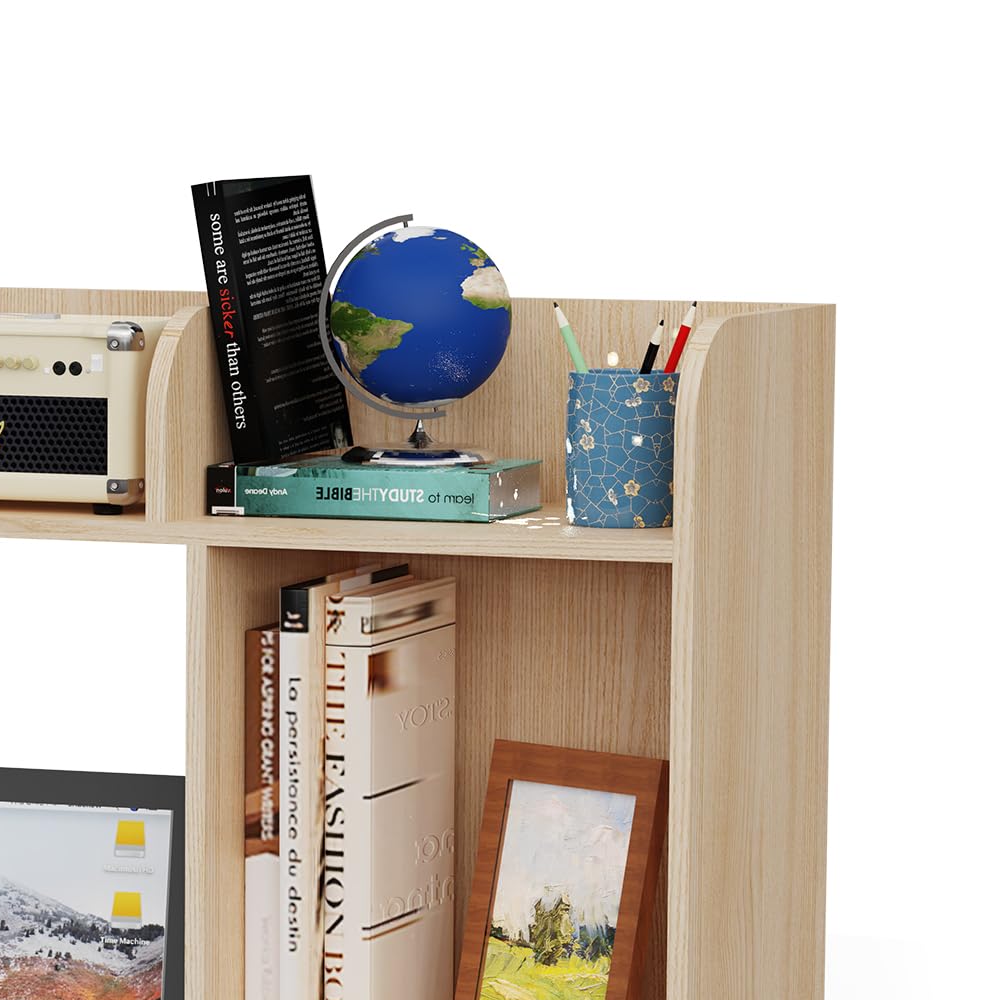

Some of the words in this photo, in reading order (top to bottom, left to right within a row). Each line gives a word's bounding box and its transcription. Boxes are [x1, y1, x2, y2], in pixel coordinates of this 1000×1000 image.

[210, 213, 225, 256] some
[216, 259, 228, 284] are
[219, 288, 237, 339] sicker
[226, 342, 241, 377] than
[231, 380, 247, 430] others
[288, 676, 302, 702] La
[326, 652, 346, 741] THE
[286, 710, 302, 840] persistance
[288, 848, 302, 877] du
[324, 753, 346, 936] FASHION
[288, 886, 302, 953] destin
